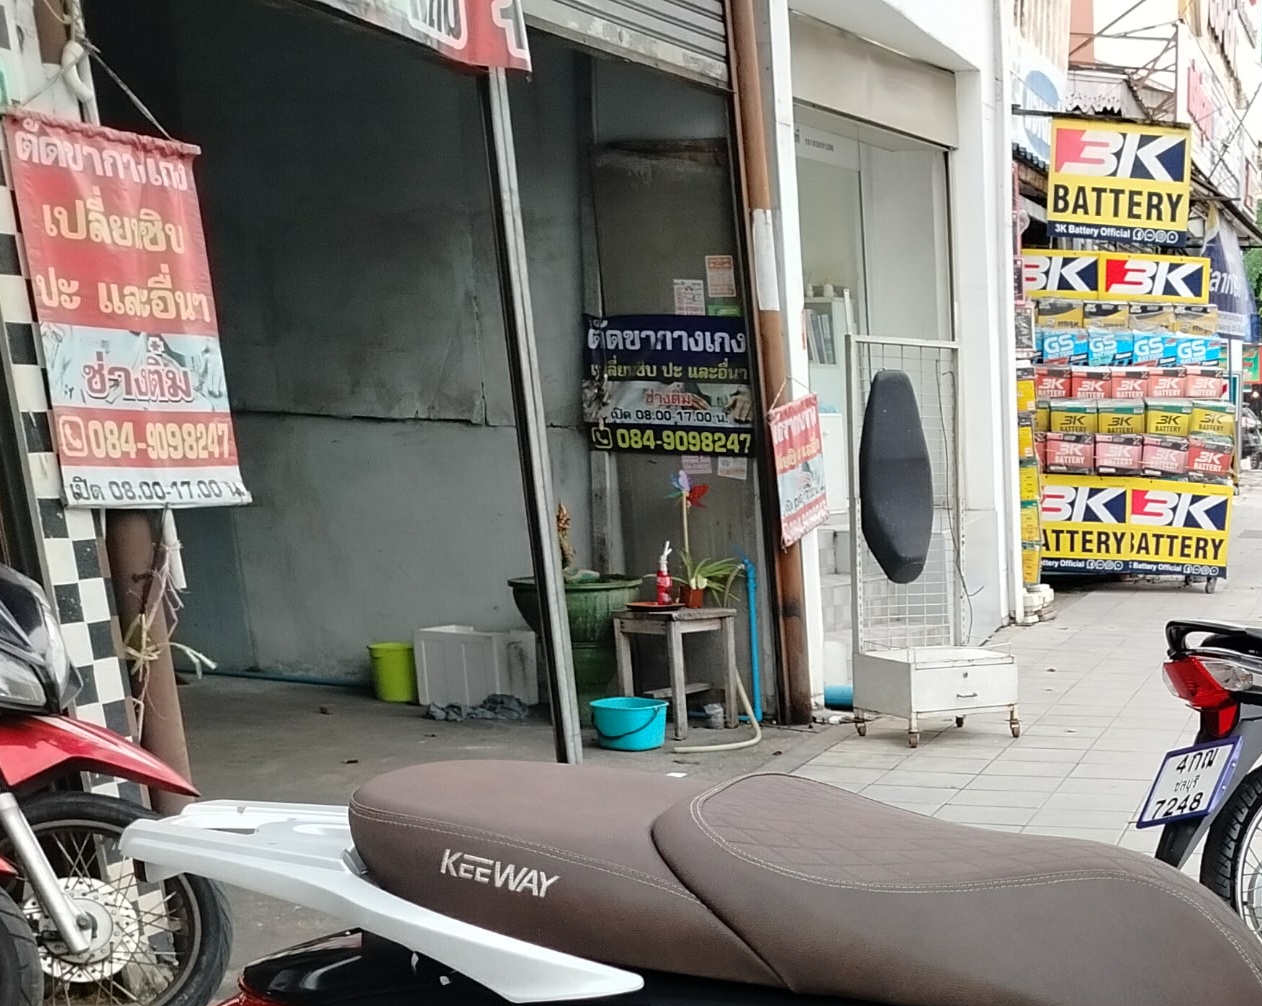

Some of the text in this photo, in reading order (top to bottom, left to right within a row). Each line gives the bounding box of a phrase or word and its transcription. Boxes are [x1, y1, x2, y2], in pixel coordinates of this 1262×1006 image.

[15, 118, 188, 191] ตัดขากางเกง
[1059, 130, 1187, 182] 3K
[1053, 183, 1184, 222] BATTERY
[1055, 224, 1131, 238] 3K Battery Official
[1110, 259, 1202, 297] 3K
[36, 264, 211, 323] ปะ และอื่นๆ
[588, 319, 746, 353] ตัดขากางเกง
[1044, 334, 1074, 354] GS
[1089, 334, 1117, 352] GS
[1134, 337, 1164, 356] GS
[1177, 340, 1206, 359] GS
[662, 362, 682, 377] ปะ
[1039, 379, 1064, 389] 3K
[1078, 381, 1104, 391] 3K
[1117, 380, 1142, 390] 3K
[1154, 378, 1180, 389] 3K
[1190, 378, 1215, 389] 3K
[611, 407, 632, 421] เปิด
[1060, 415, 1087, 426] 3K
[1108, 417, 1134, 427] 3K
[1156, 415, 1181, 425] 3K
[1155, 425, 1181, 433] BATTERY
[88, 419, 229, 459] 084-9098247
[616, 428, 751, 453] 084-9098247
[1194, 452, 1220, 464] 3K
[69, 476, 105, 501] เปิด
[109, 480, 222, 500] 08.00-17.00
[1131, 490, 1228, 531] 3K
[1060, 560, 1085, 568] Official
[1133, 562, 1182, 572] Battery Official
[1152, 792, 1203, 819] 7248
[440, 849, 560, 898] KEEWAY
